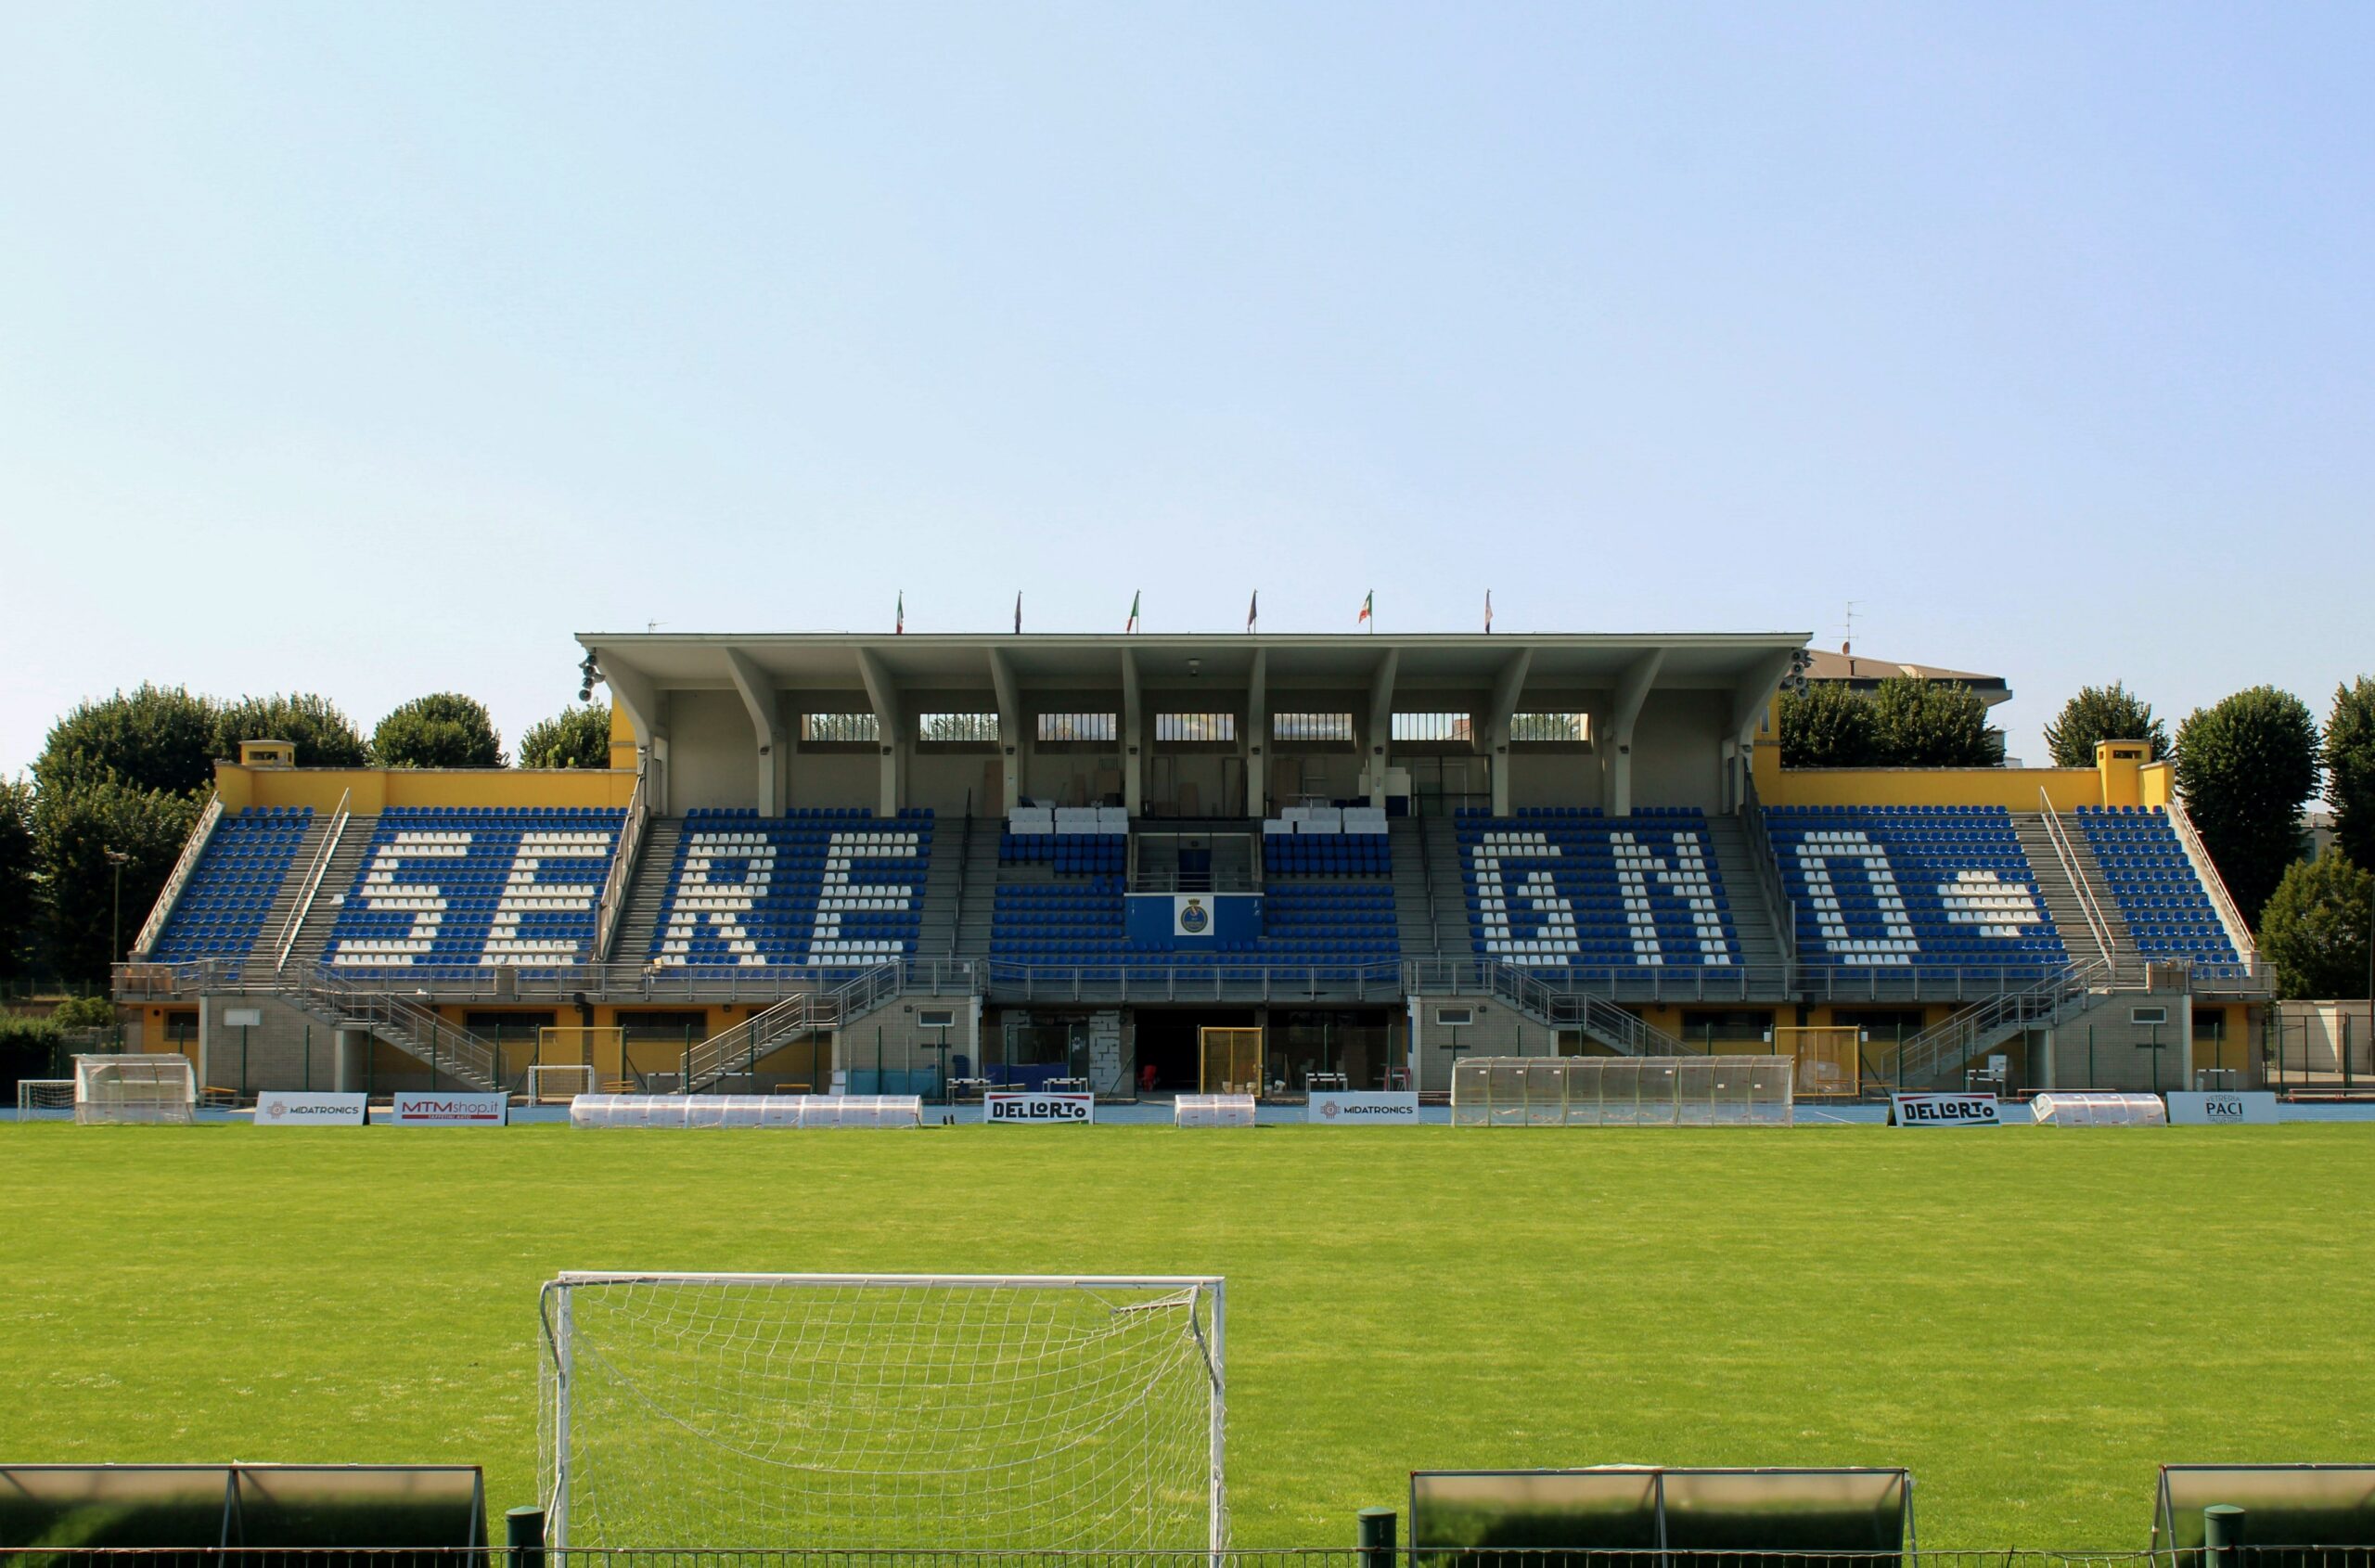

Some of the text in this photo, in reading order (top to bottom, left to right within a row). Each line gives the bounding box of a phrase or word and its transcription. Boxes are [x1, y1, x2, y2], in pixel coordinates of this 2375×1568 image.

[289, 1106, 359, 1114] MIDATRONICS
[402, 1100, 499, 1114] MTMshop.it
[993, 1101, 1086, 1118] DELLORTO
[1343, 1106, 1413, 1114] MIDATRONICS
[1904, 1101, 1995, 1120] DELLORTO
[2205, 1102, 2243, 1114] PACI
